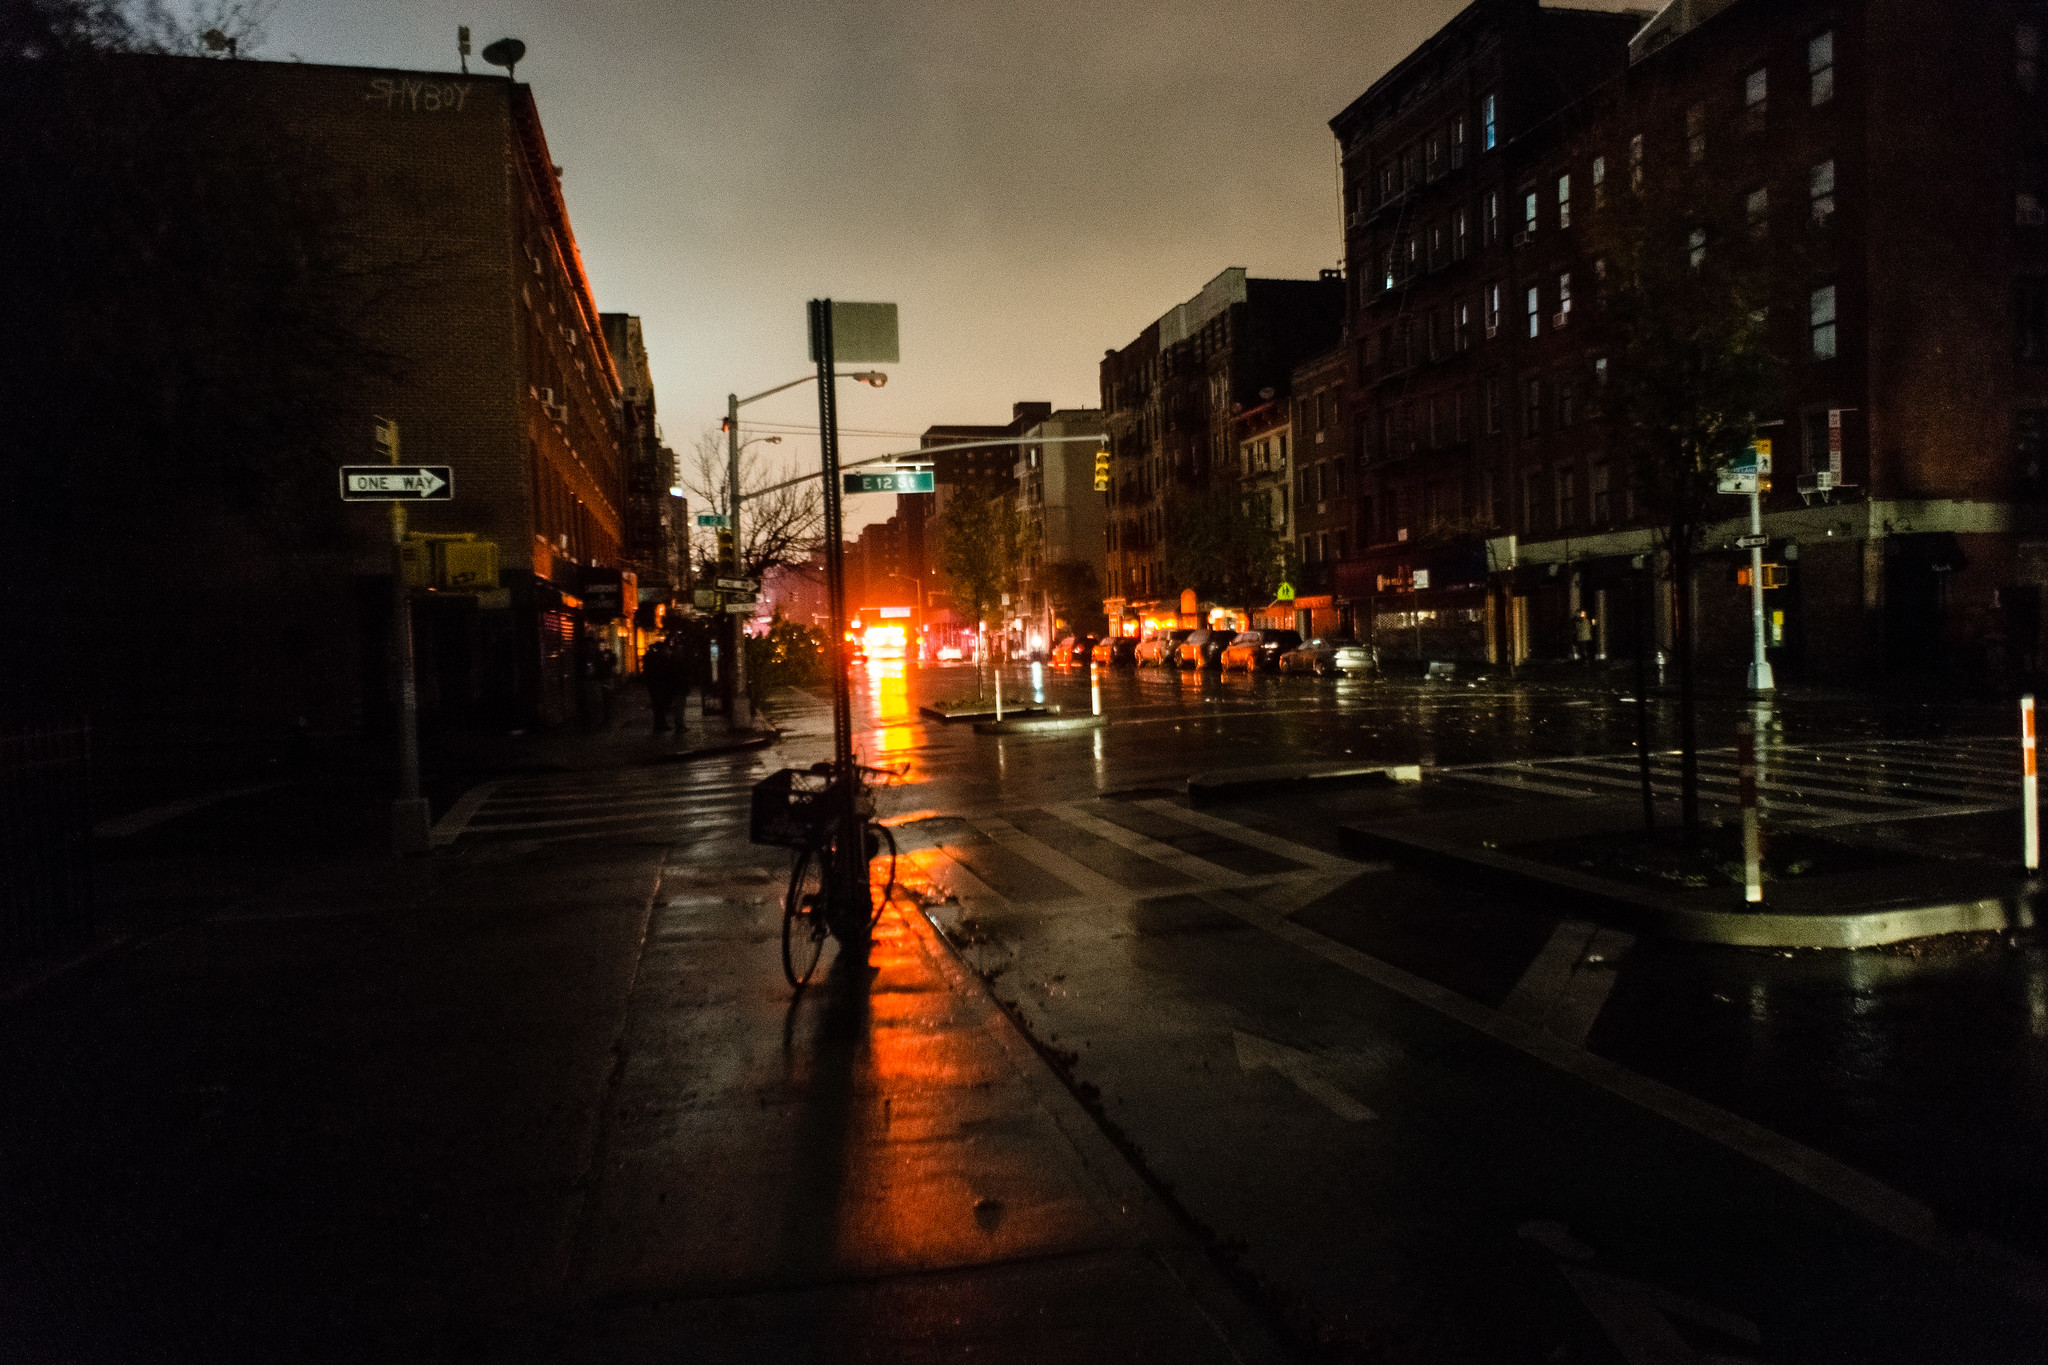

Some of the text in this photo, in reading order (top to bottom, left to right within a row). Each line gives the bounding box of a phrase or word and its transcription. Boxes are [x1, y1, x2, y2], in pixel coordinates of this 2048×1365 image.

[357, 477, 434, 490] ONE WAY
[863, 476, 916, 490] E 12 St
